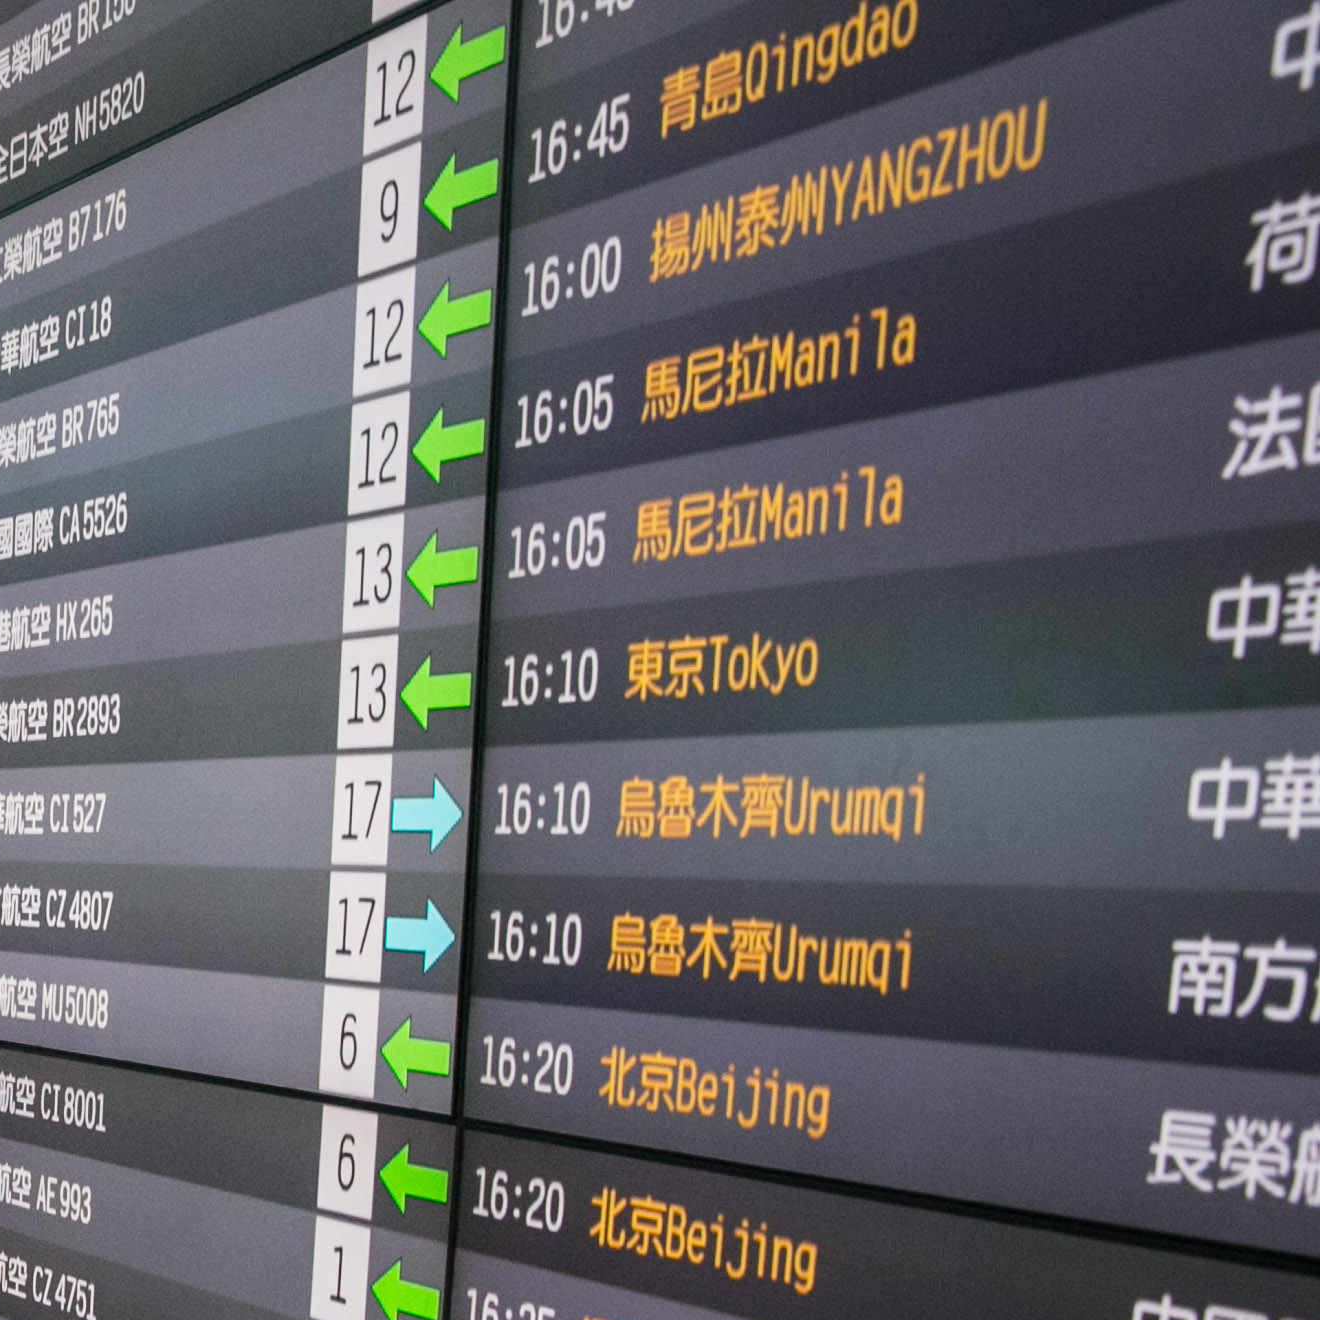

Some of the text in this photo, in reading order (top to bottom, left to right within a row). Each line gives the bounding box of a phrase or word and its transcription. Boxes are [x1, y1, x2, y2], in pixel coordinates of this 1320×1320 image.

[373, 49, 416, 127] 12
[528, 0, 918, 183] 16:45 青島Qingdao
[379, 179, 400, 243] 9
[521, 235, 622, 317] 16:00
[362, 298, 405, 370] 12
[515, 307, 917, 449] 16:05 馬尼拉Manila
[357, 421, 399, 489] 12
[508, 466, 904, 579] 16:05 馬尼拉Manila
[352, 542, 393, 607] 13
[347, 662, 387, 725] 13
[501, 632, 819, 707] 16:10 東京Tokyo
[341, 780, 383, 841] 17
[494, 781, 591, 835] 16:10
[335, 897, 376, 956] 17
[487, 910, 583, 966] 16:10
[339, 1012, 358, 1071] 6
[480, 1035, 831, 1139] 16:20 北京Beijing
[337, 1133, 356, 1192] 6
[472, 1166, 818, 1295] 16:20 北京Beijing
[329, 1246, 347, 1305] 1
